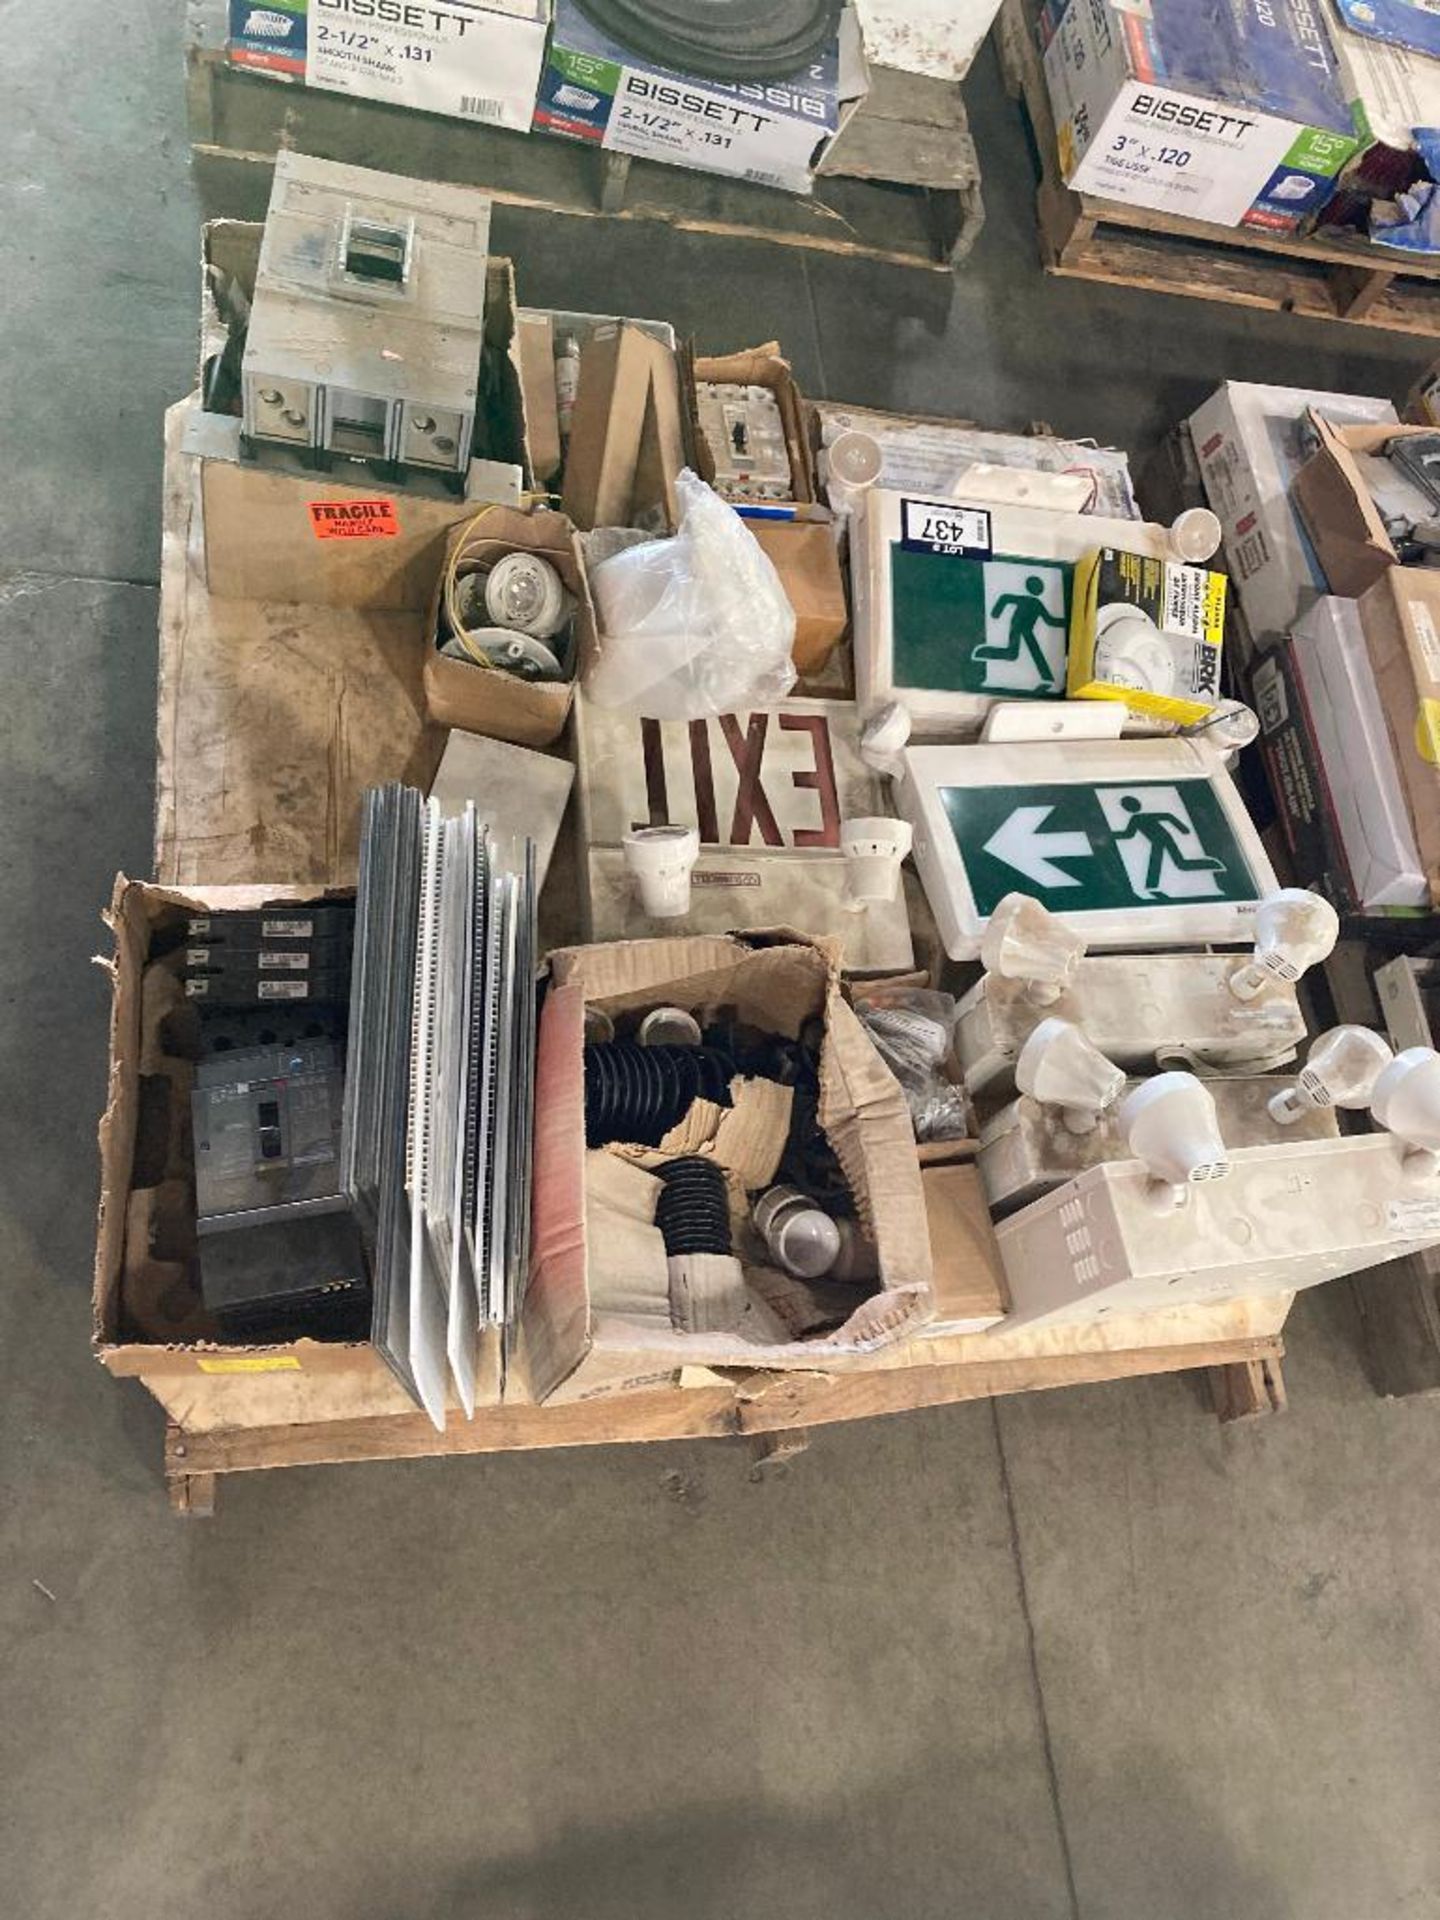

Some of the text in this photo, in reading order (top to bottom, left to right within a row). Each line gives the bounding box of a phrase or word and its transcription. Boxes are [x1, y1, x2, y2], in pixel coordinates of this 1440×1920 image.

[317, 26, 378, 49] 2-1/2"
[400, 46, 432, 62] .131
[1290, 0, 1330, 74] SSETT
[627, 77, 771, 132] BISSETT
[700, 79, 825, 118] BISS
[1130, 94, 1254, 139] BISSETT
[619, 106, 682, 130] 2-1/2"
[699, 132, 732, 148] .131
[1112, 135, 1139, 152] 3"
[1151, 147, 1191, 168] .120
[312, 505, 392, 521] FRAGILE
[922, 518, 963, 542] 437
[943, 544, 963, 556] LOT
[1199, 644, 1217, 696] BRK
[631, 713, 840, 848] EXIT
